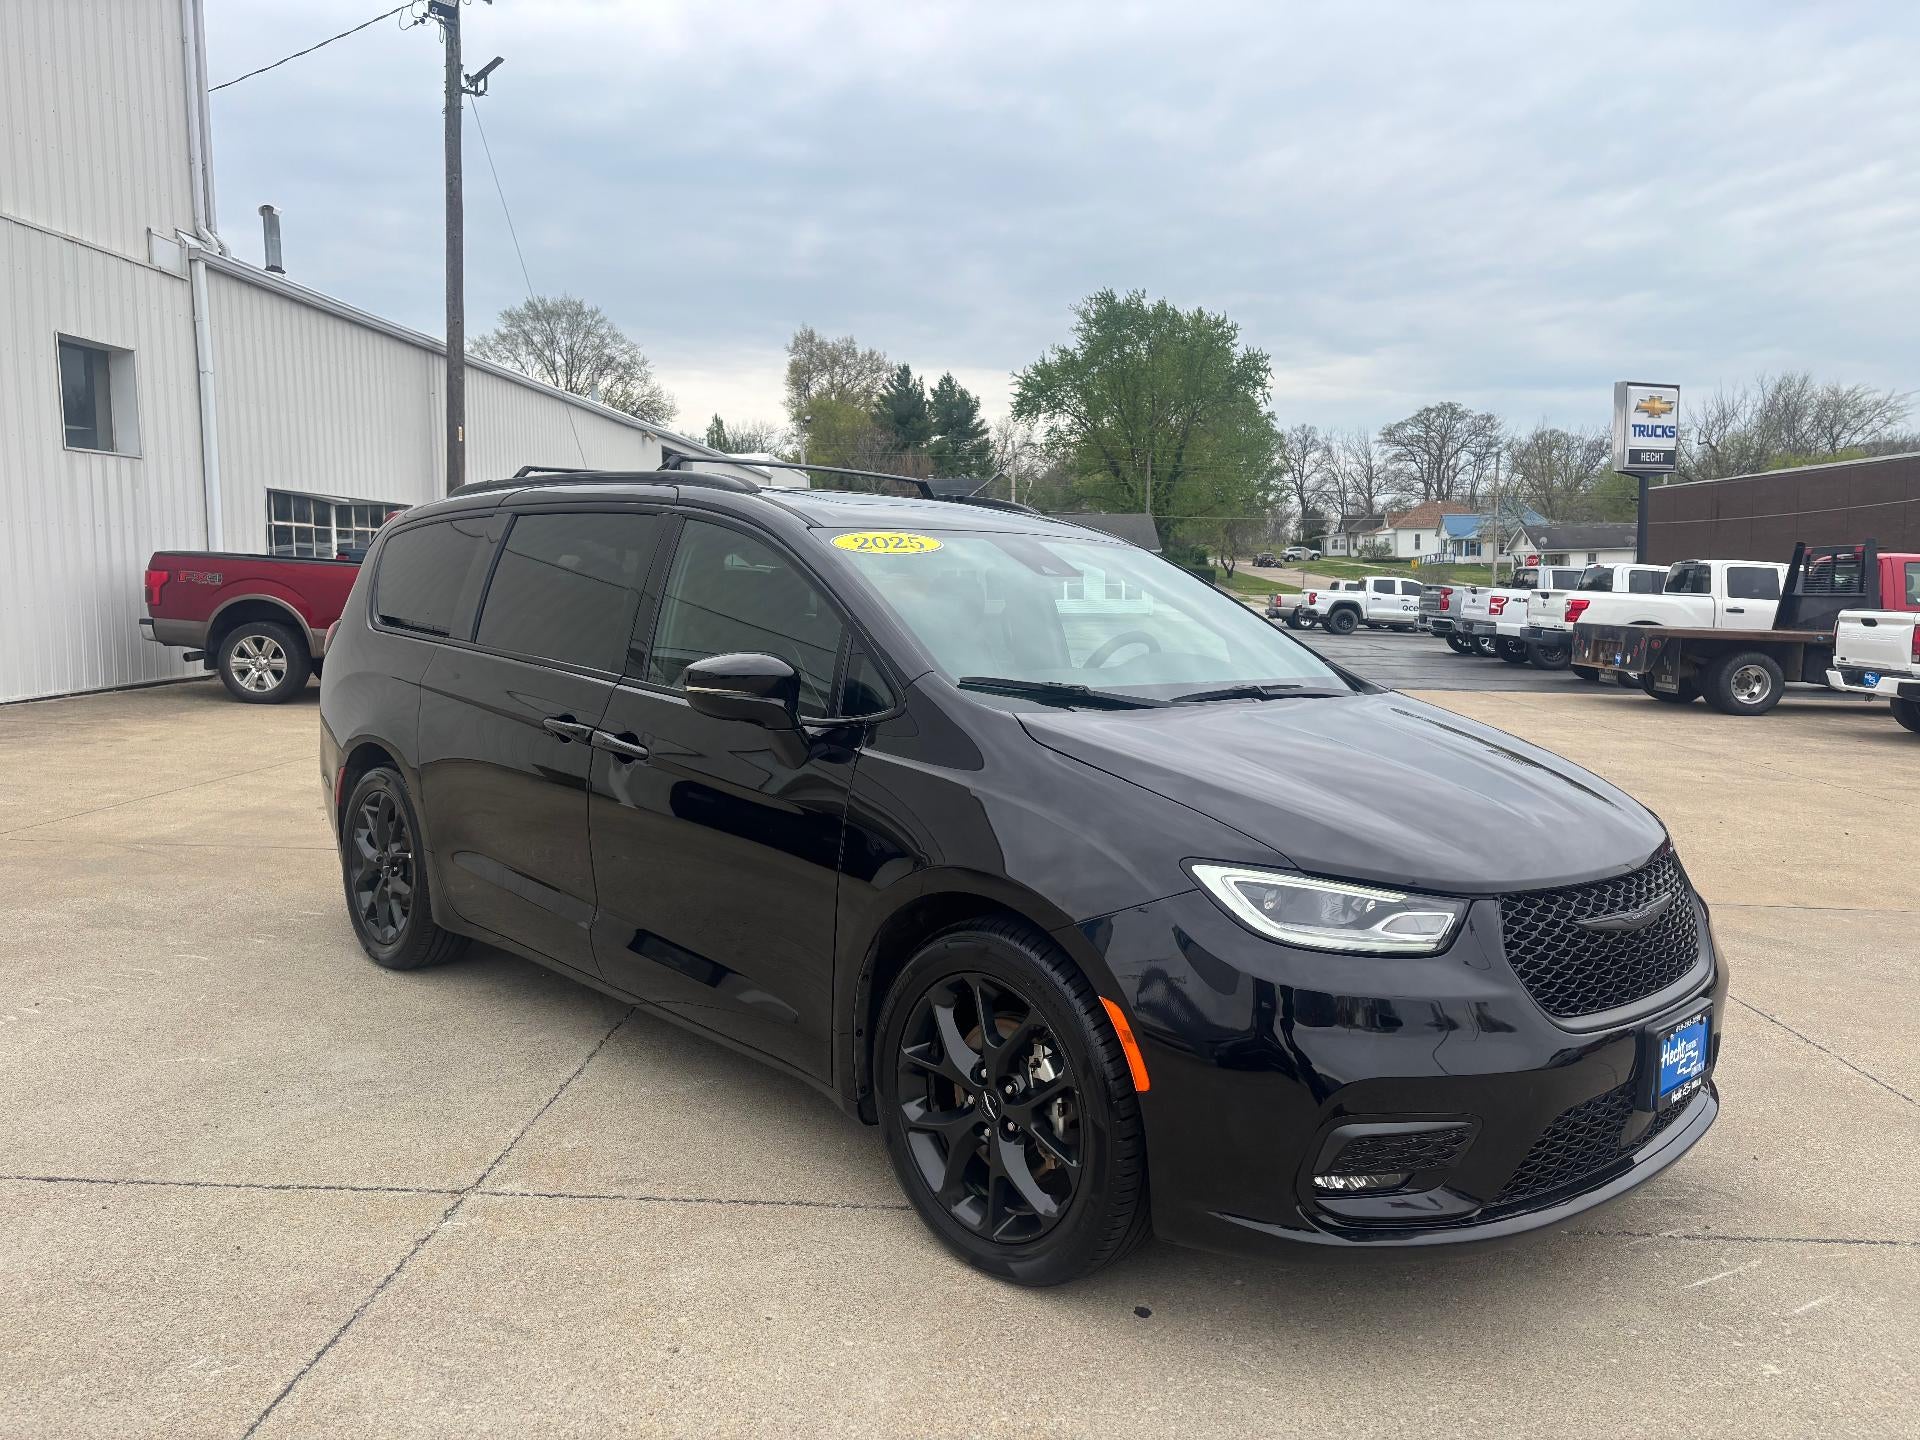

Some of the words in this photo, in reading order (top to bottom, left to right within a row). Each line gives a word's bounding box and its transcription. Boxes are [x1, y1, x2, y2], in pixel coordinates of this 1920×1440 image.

[1632, 424, 1675, 438] TRUCKS
[1641, 452, 1664, 462] HECHT
[853, 536, 925, 550] 2025
[1661, 1038, 1687, 1069] Hecht
